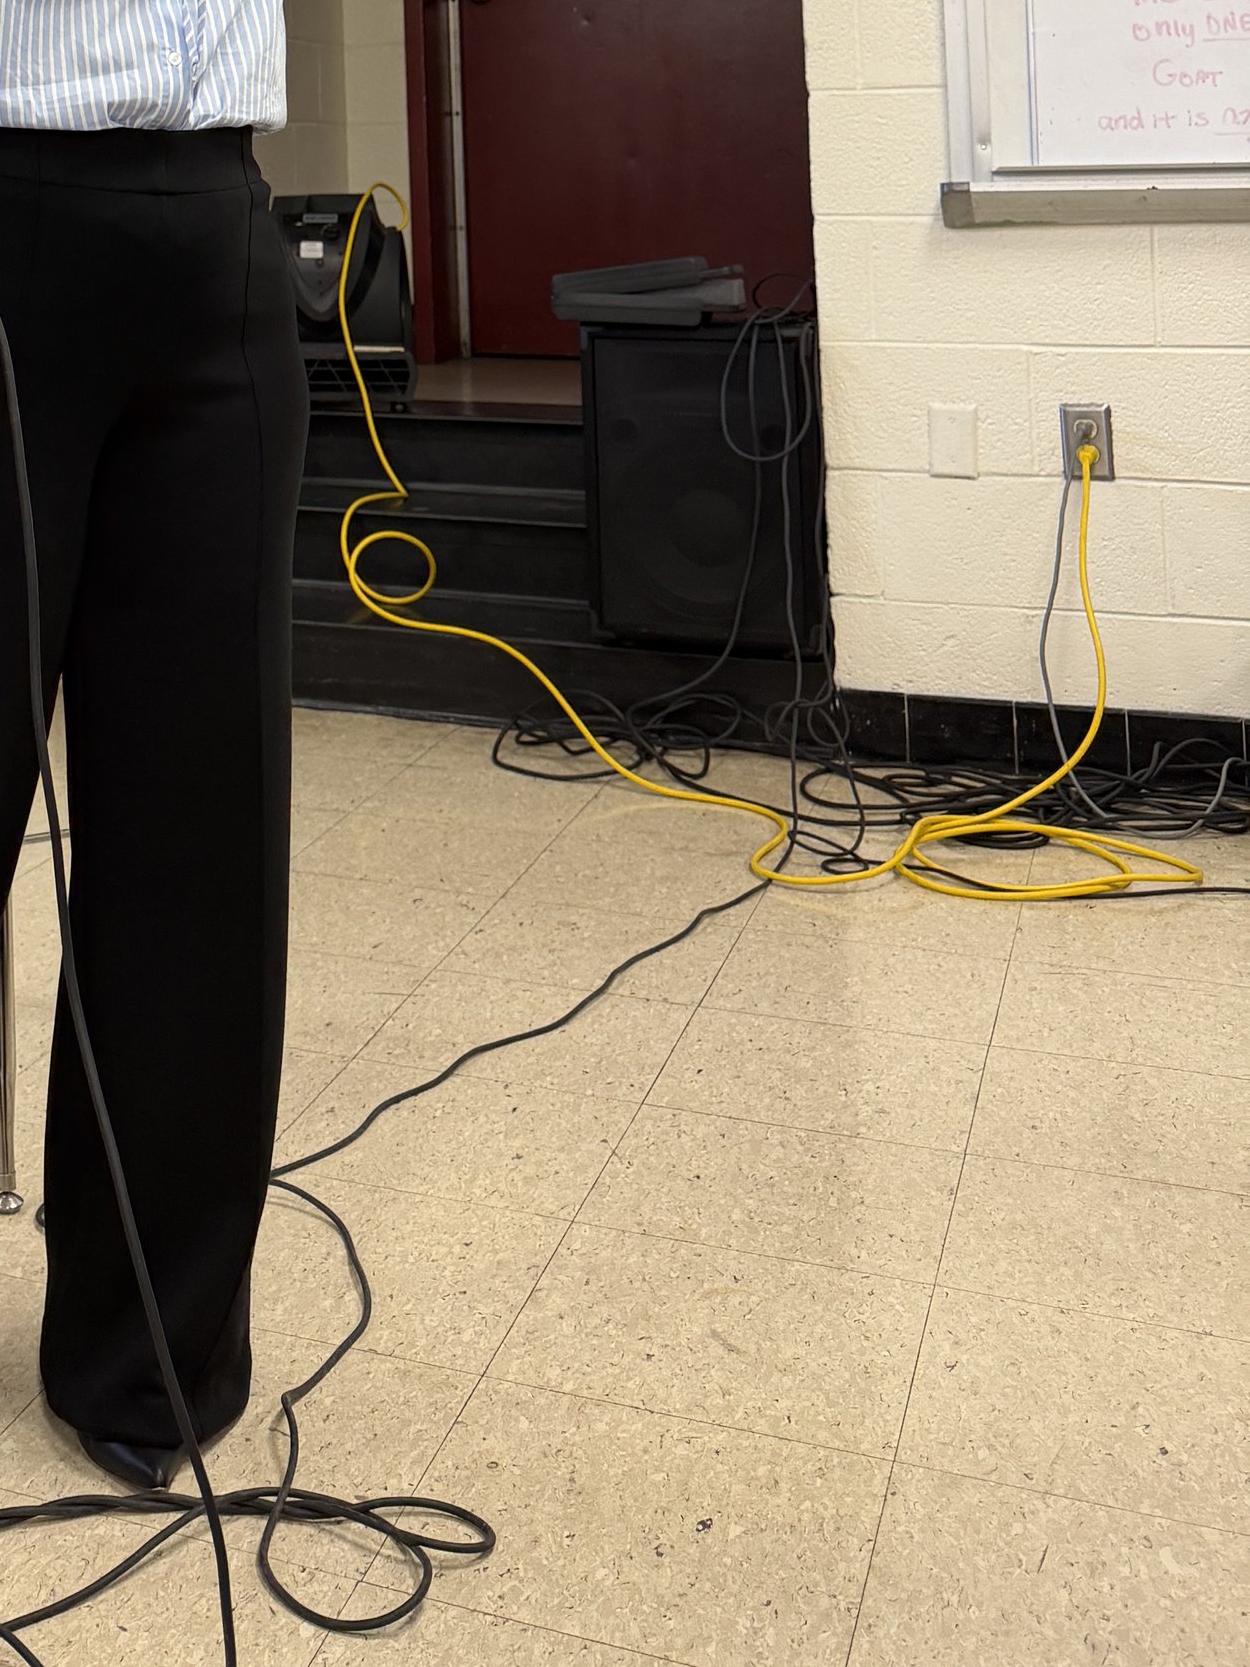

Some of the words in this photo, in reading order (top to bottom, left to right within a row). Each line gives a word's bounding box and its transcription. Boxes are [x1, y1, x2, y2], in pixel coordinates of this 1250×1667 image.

[1132, 19, 1195, 48] only
[1098, 107, 1145, 131] and
[1153, 110, 1176, 129] it
[1187, 109, 1210, 127] is
